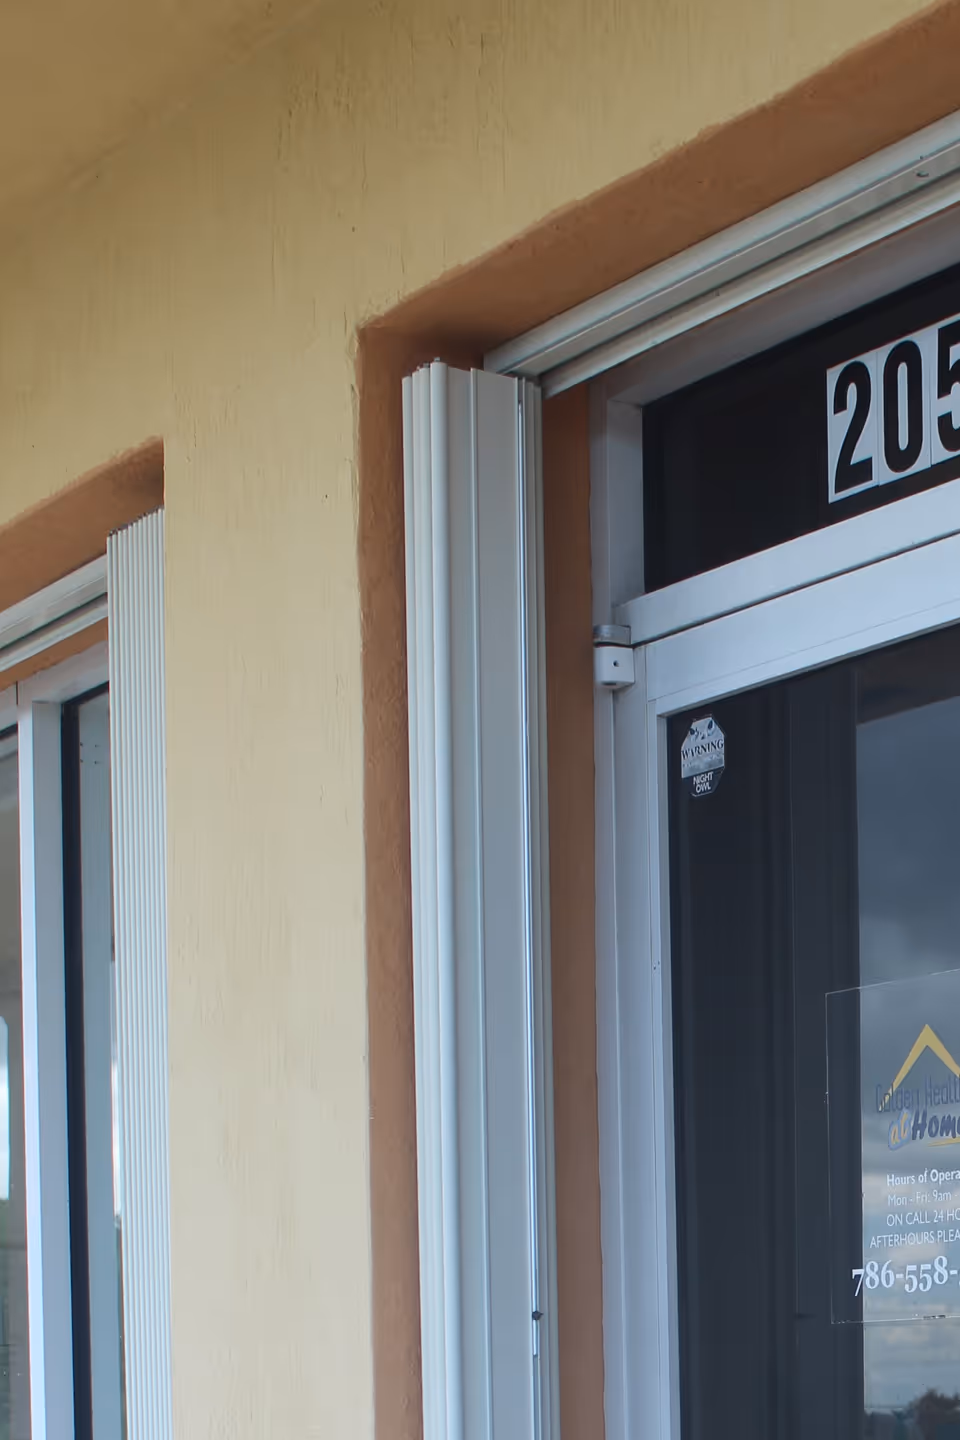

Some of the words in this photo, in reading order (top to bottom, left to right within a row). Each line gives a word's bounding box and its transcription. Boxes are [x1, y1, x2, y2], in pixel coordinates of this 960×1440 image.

[681, 739, 724, 761] WARNING
[693, 771, 714, 785] NIGHT
[695, 781, 712, 793] OWL
[888, 1109, 912, 1149] at
[886, 1173, 916, 1187] Hours
[918, 1168, 928, 1184] of
[888, 1193, 908, 1207] Mon
[932, 1189, 952, 1202] 9am
[886, 1212, 903, 1227] ON
[905, 1210, 931, 1225] CALL
[933, 1209, 945, 1223] 24
[870, 1231, 935, 1249] AFTERHOURS
